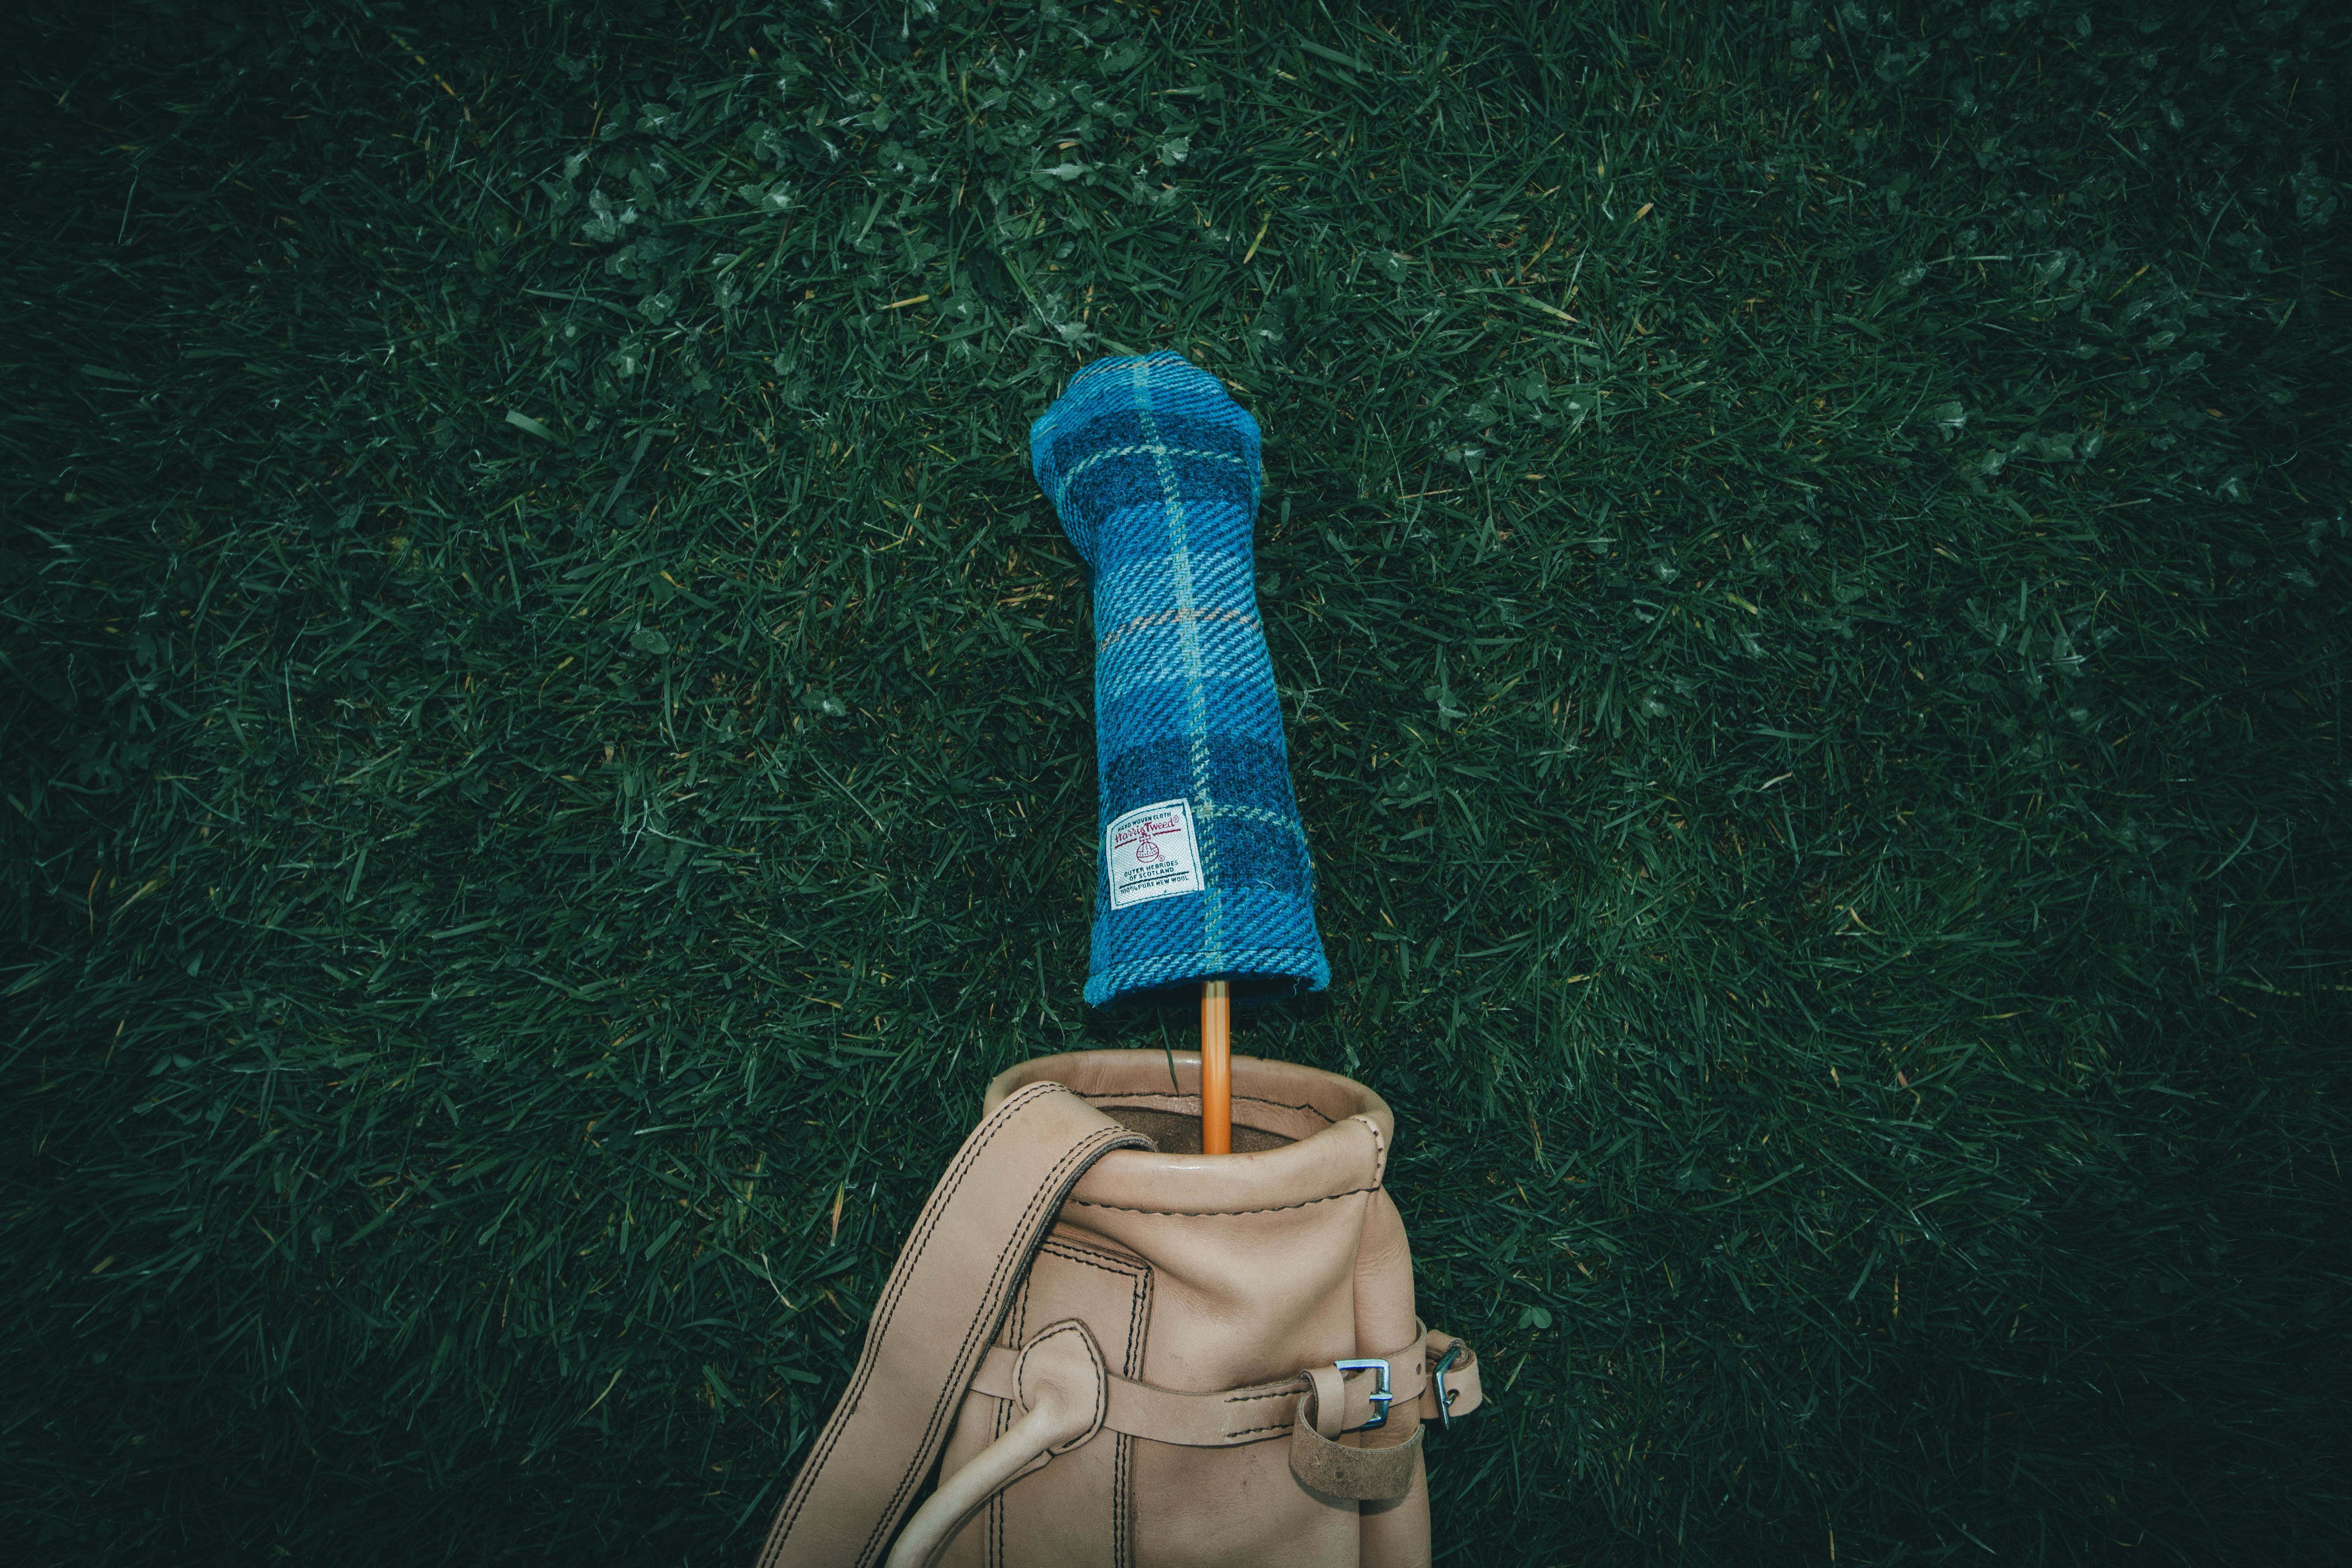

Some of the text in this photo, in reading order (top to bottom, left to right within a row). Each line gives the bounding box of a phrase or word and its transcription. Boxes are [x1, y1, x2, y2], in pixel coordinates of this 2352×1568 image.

[1118, 823, 1131, 832] HAND
[1132, 816, 1152, 825] WOVEN
[1124, 861, 1179, 877] OUTER HEBRIDES
[1139, 867, 1174, 878] SCOTLAND
[1121, 886, 1138, 894] 100%
[1138, 881, 1155, 889] PURE
